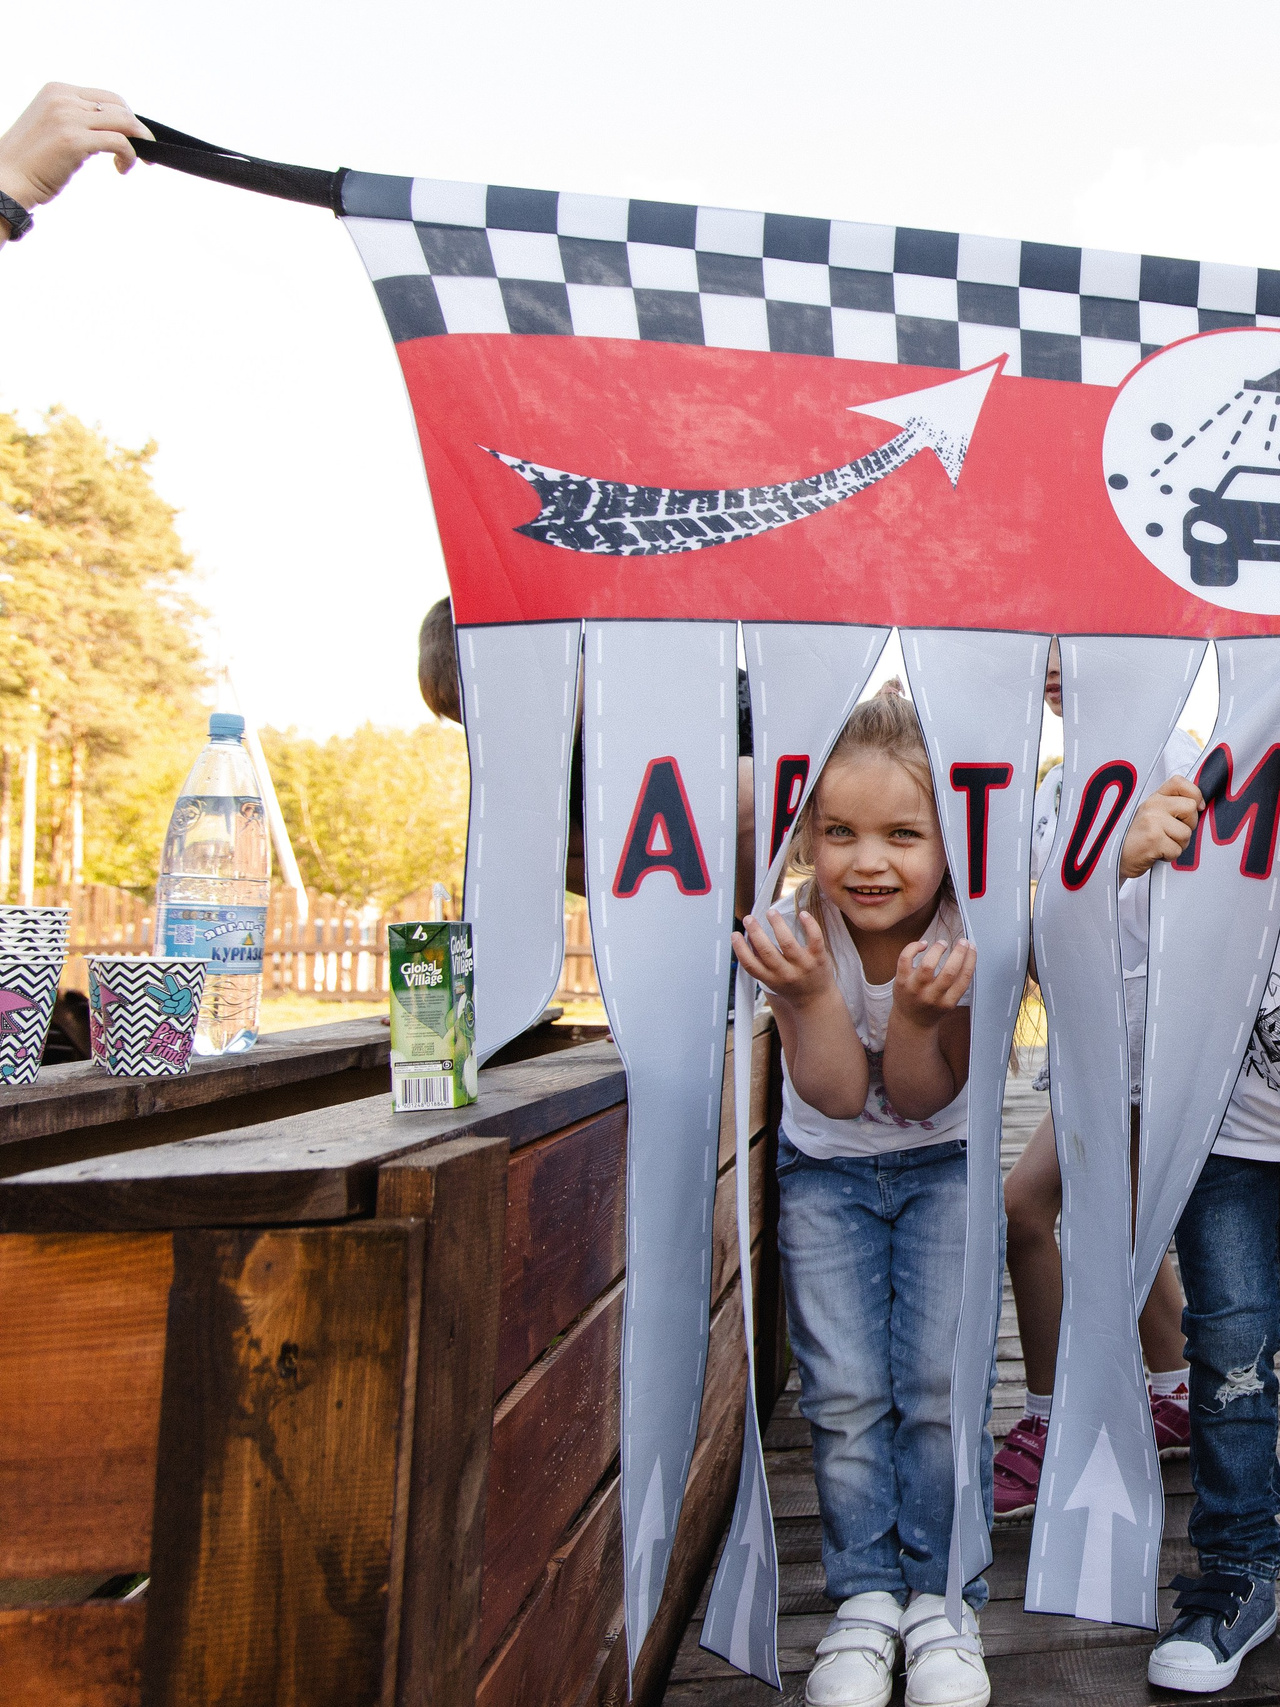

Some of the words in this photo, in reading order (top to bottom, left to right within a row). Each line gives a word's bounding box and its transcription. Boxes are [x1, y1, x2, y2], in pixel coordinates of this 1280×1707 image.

[400, 960, 438, 975] Global
[404, 972, 443, 987] Village
[150, 1021, 194, 1052] Party
[143, 1037, 190, 1067] Time!
